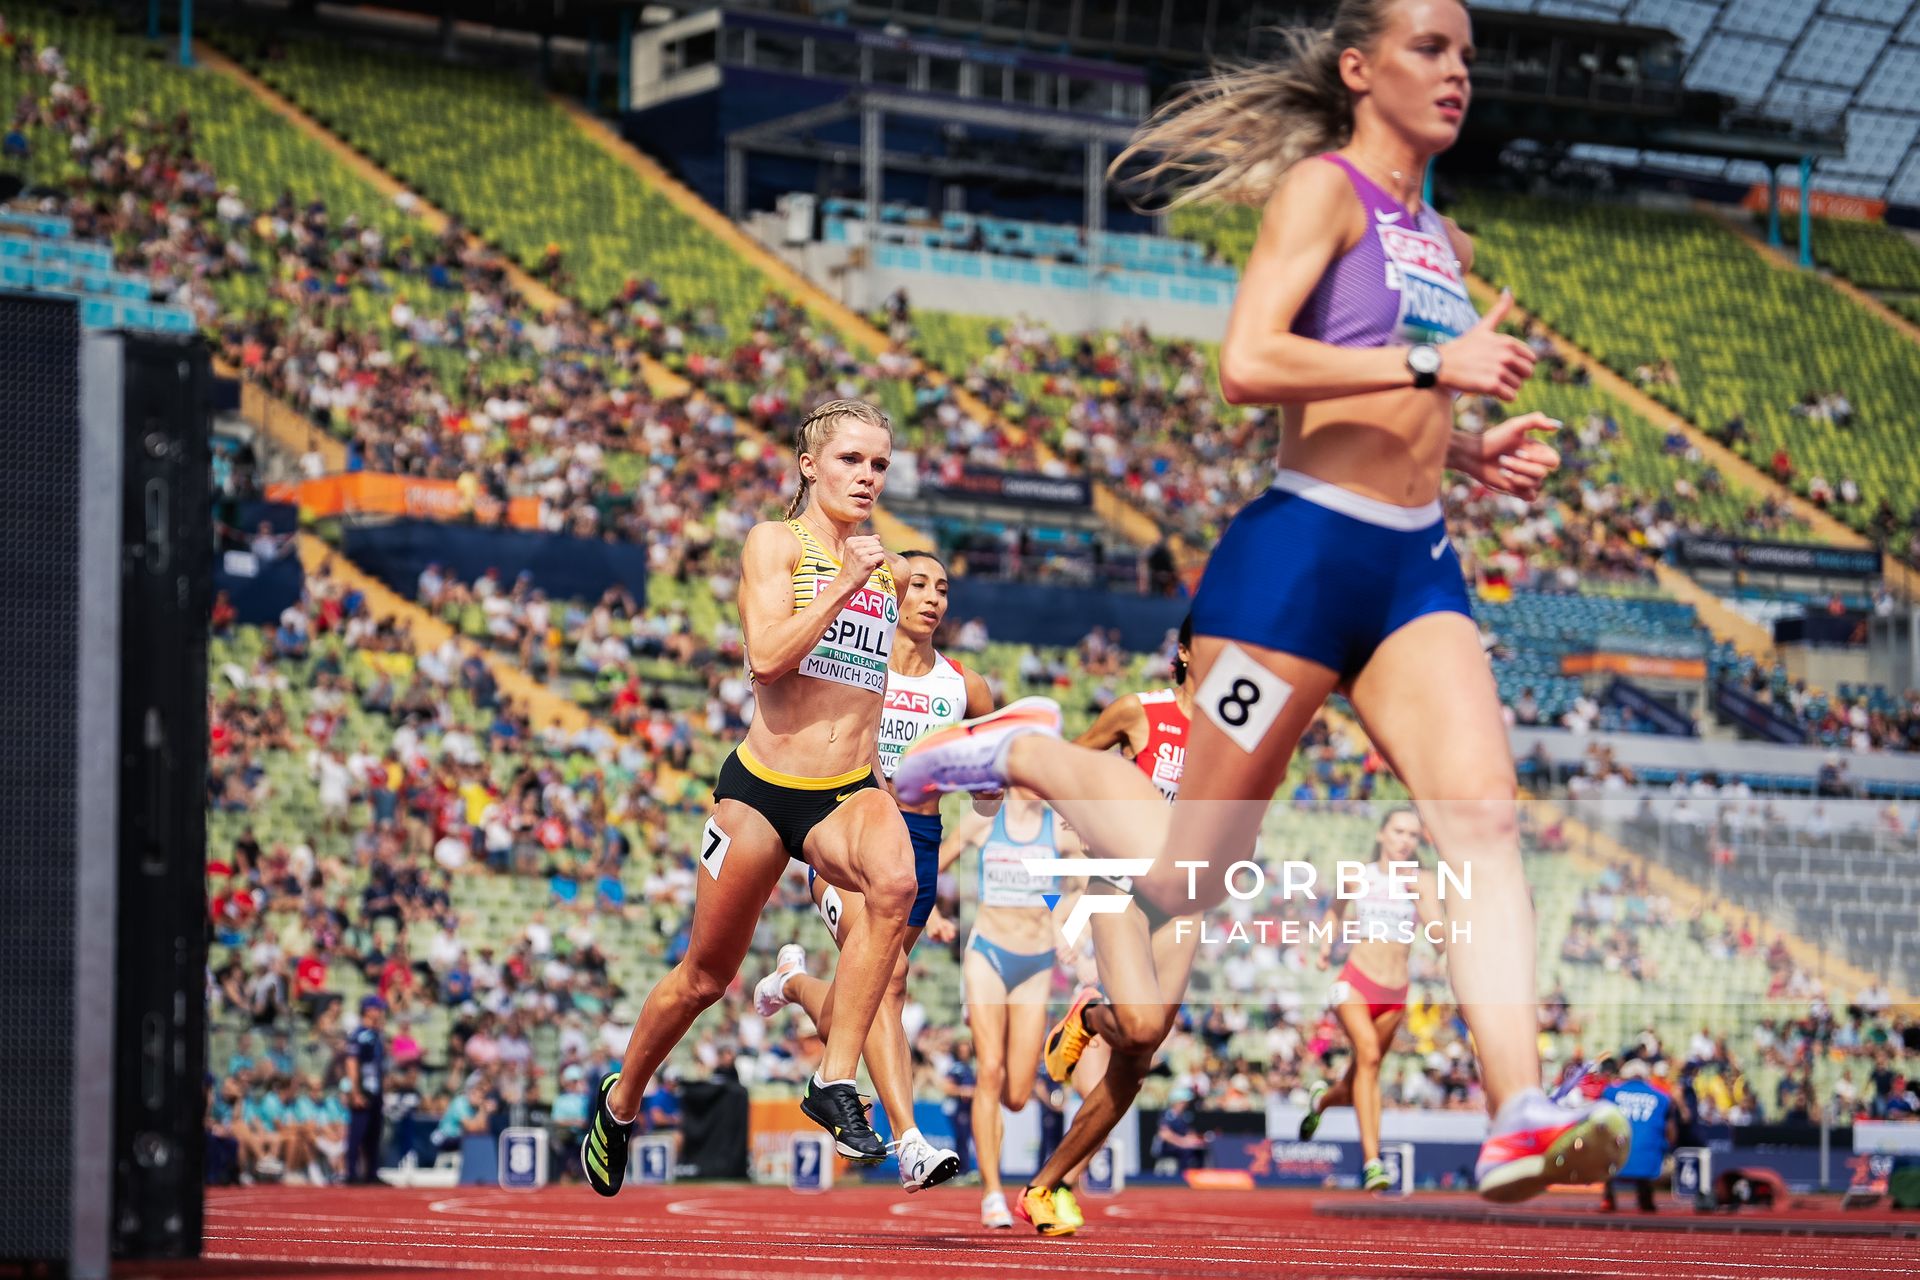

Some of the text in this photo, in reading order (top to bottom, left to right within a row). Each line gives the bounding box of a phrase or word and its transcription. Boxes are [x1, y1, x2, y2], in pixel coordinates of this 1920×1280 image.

[822, 620, 888, 657] SPILL
[807, 658, 861, 682] MUNICH
[833, 651, 851, 662] RUN
[1218, 678, 1260, 727] 8
[703, 827, 722, 861] 7
[799, 1147, 818, 1178] 7
